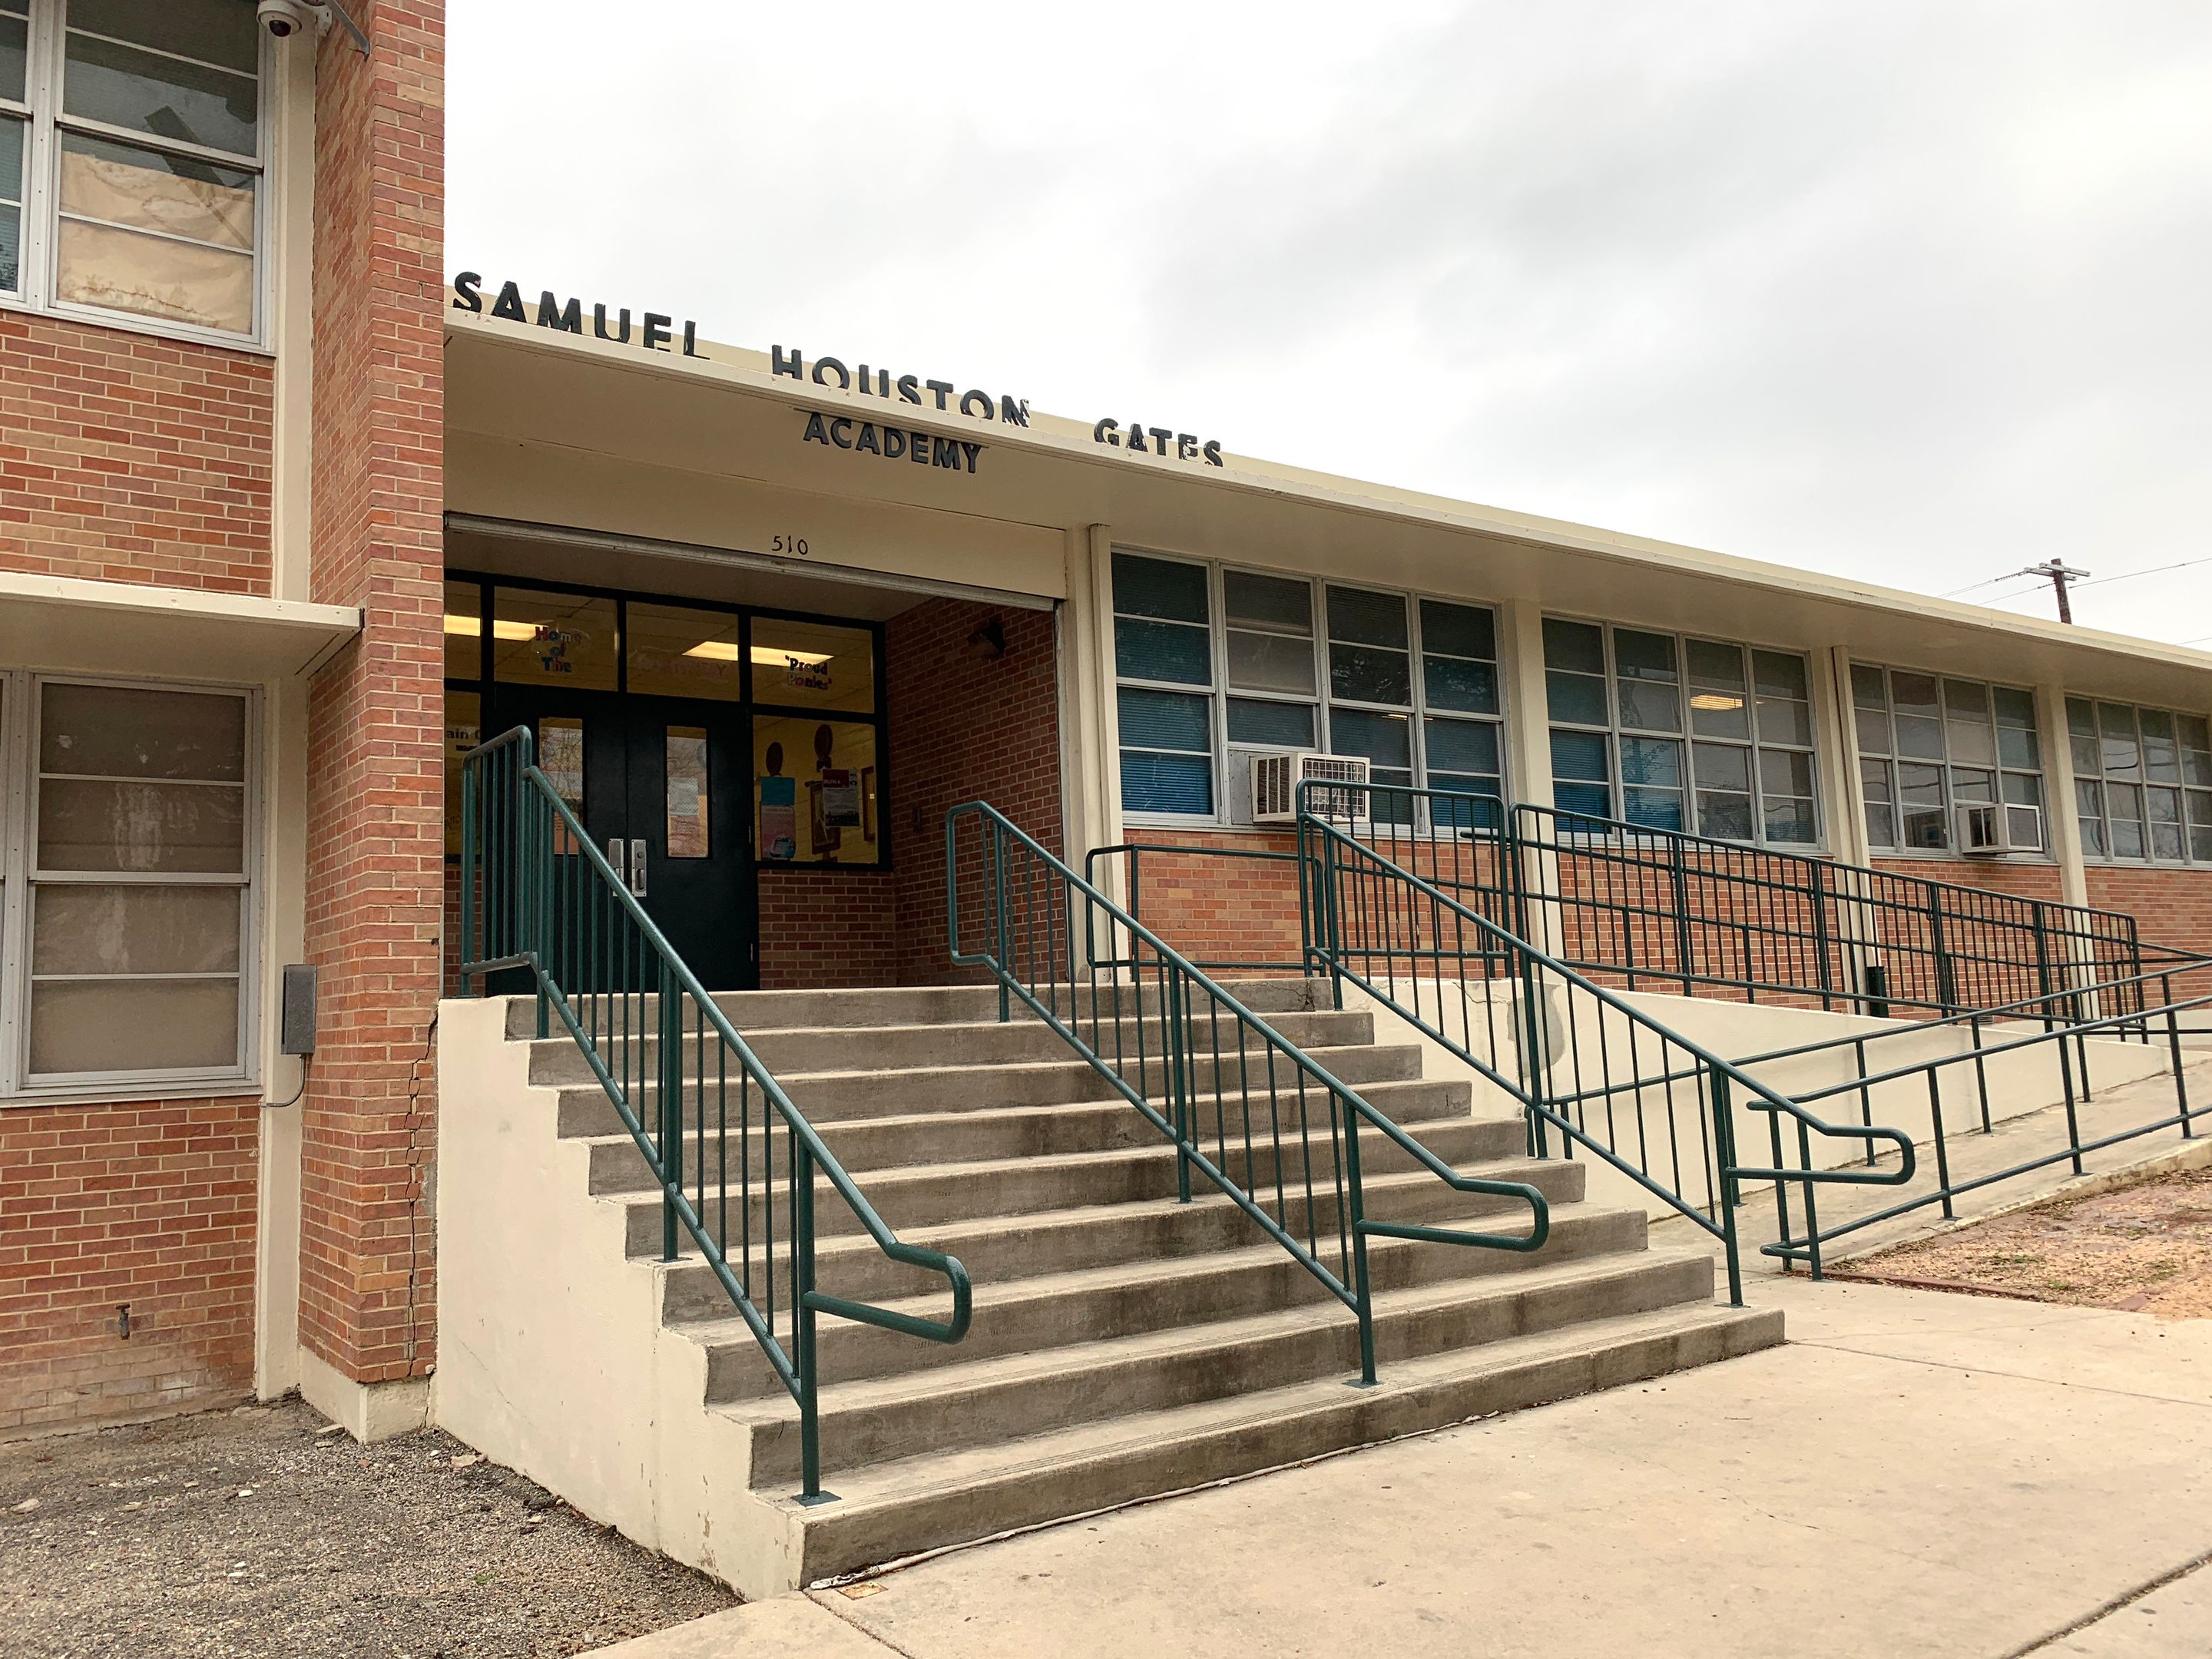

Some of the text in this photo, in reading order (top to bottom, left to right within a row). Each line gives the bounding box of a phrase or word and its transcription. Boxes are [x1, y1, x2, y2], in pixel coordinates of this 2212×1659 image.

[452, 271, 1224, 468] SAMUEL HOUSTON GATES
[803, 411, 982, 474] ACADEMY
[771, 535, 808, 555] 510
[535, 626, 582, 644] Home
[541, 656, 572, 673] The
[445, 728, 469, 740] ain
